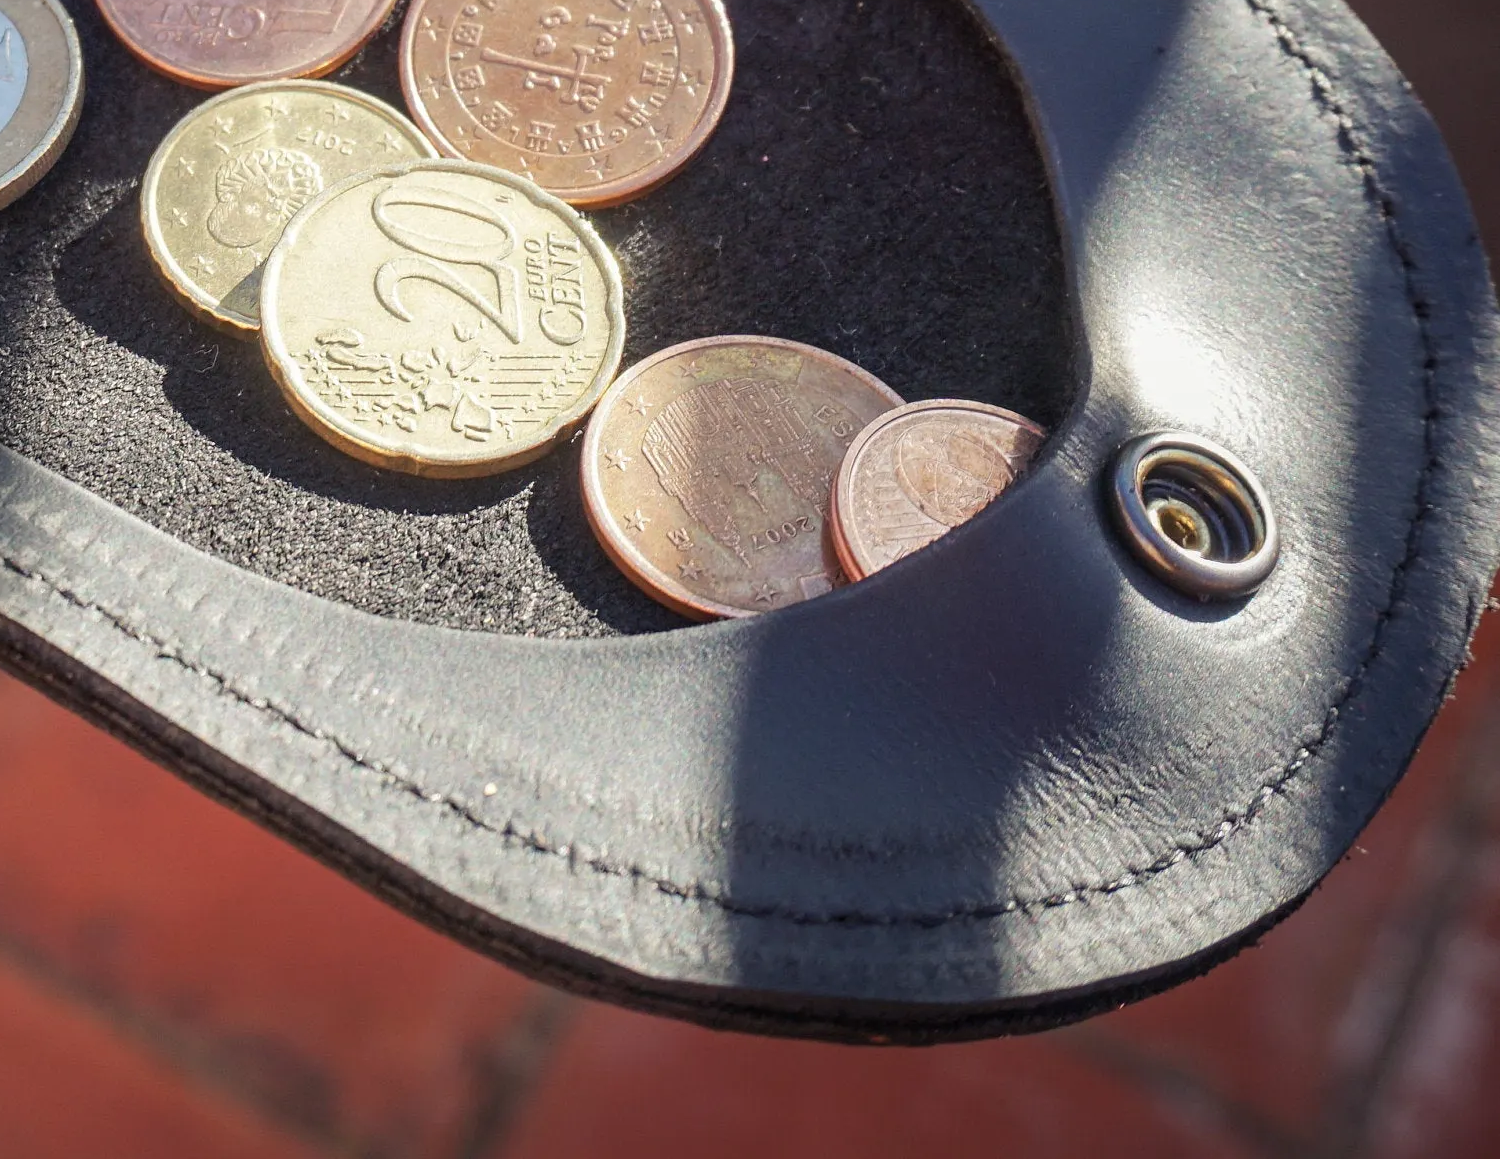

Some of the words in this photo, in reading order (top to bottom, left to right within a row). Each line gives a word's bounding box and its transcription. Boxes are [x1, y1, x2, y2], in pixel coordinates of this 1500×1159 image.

[150, 4, 266, 40] CENT
[371, 183, 524, 345] 20
[523, 238, 546, 302] EURO
[538, 231, 590, 346] CENT
[752, 515, 816, 552] 2007
